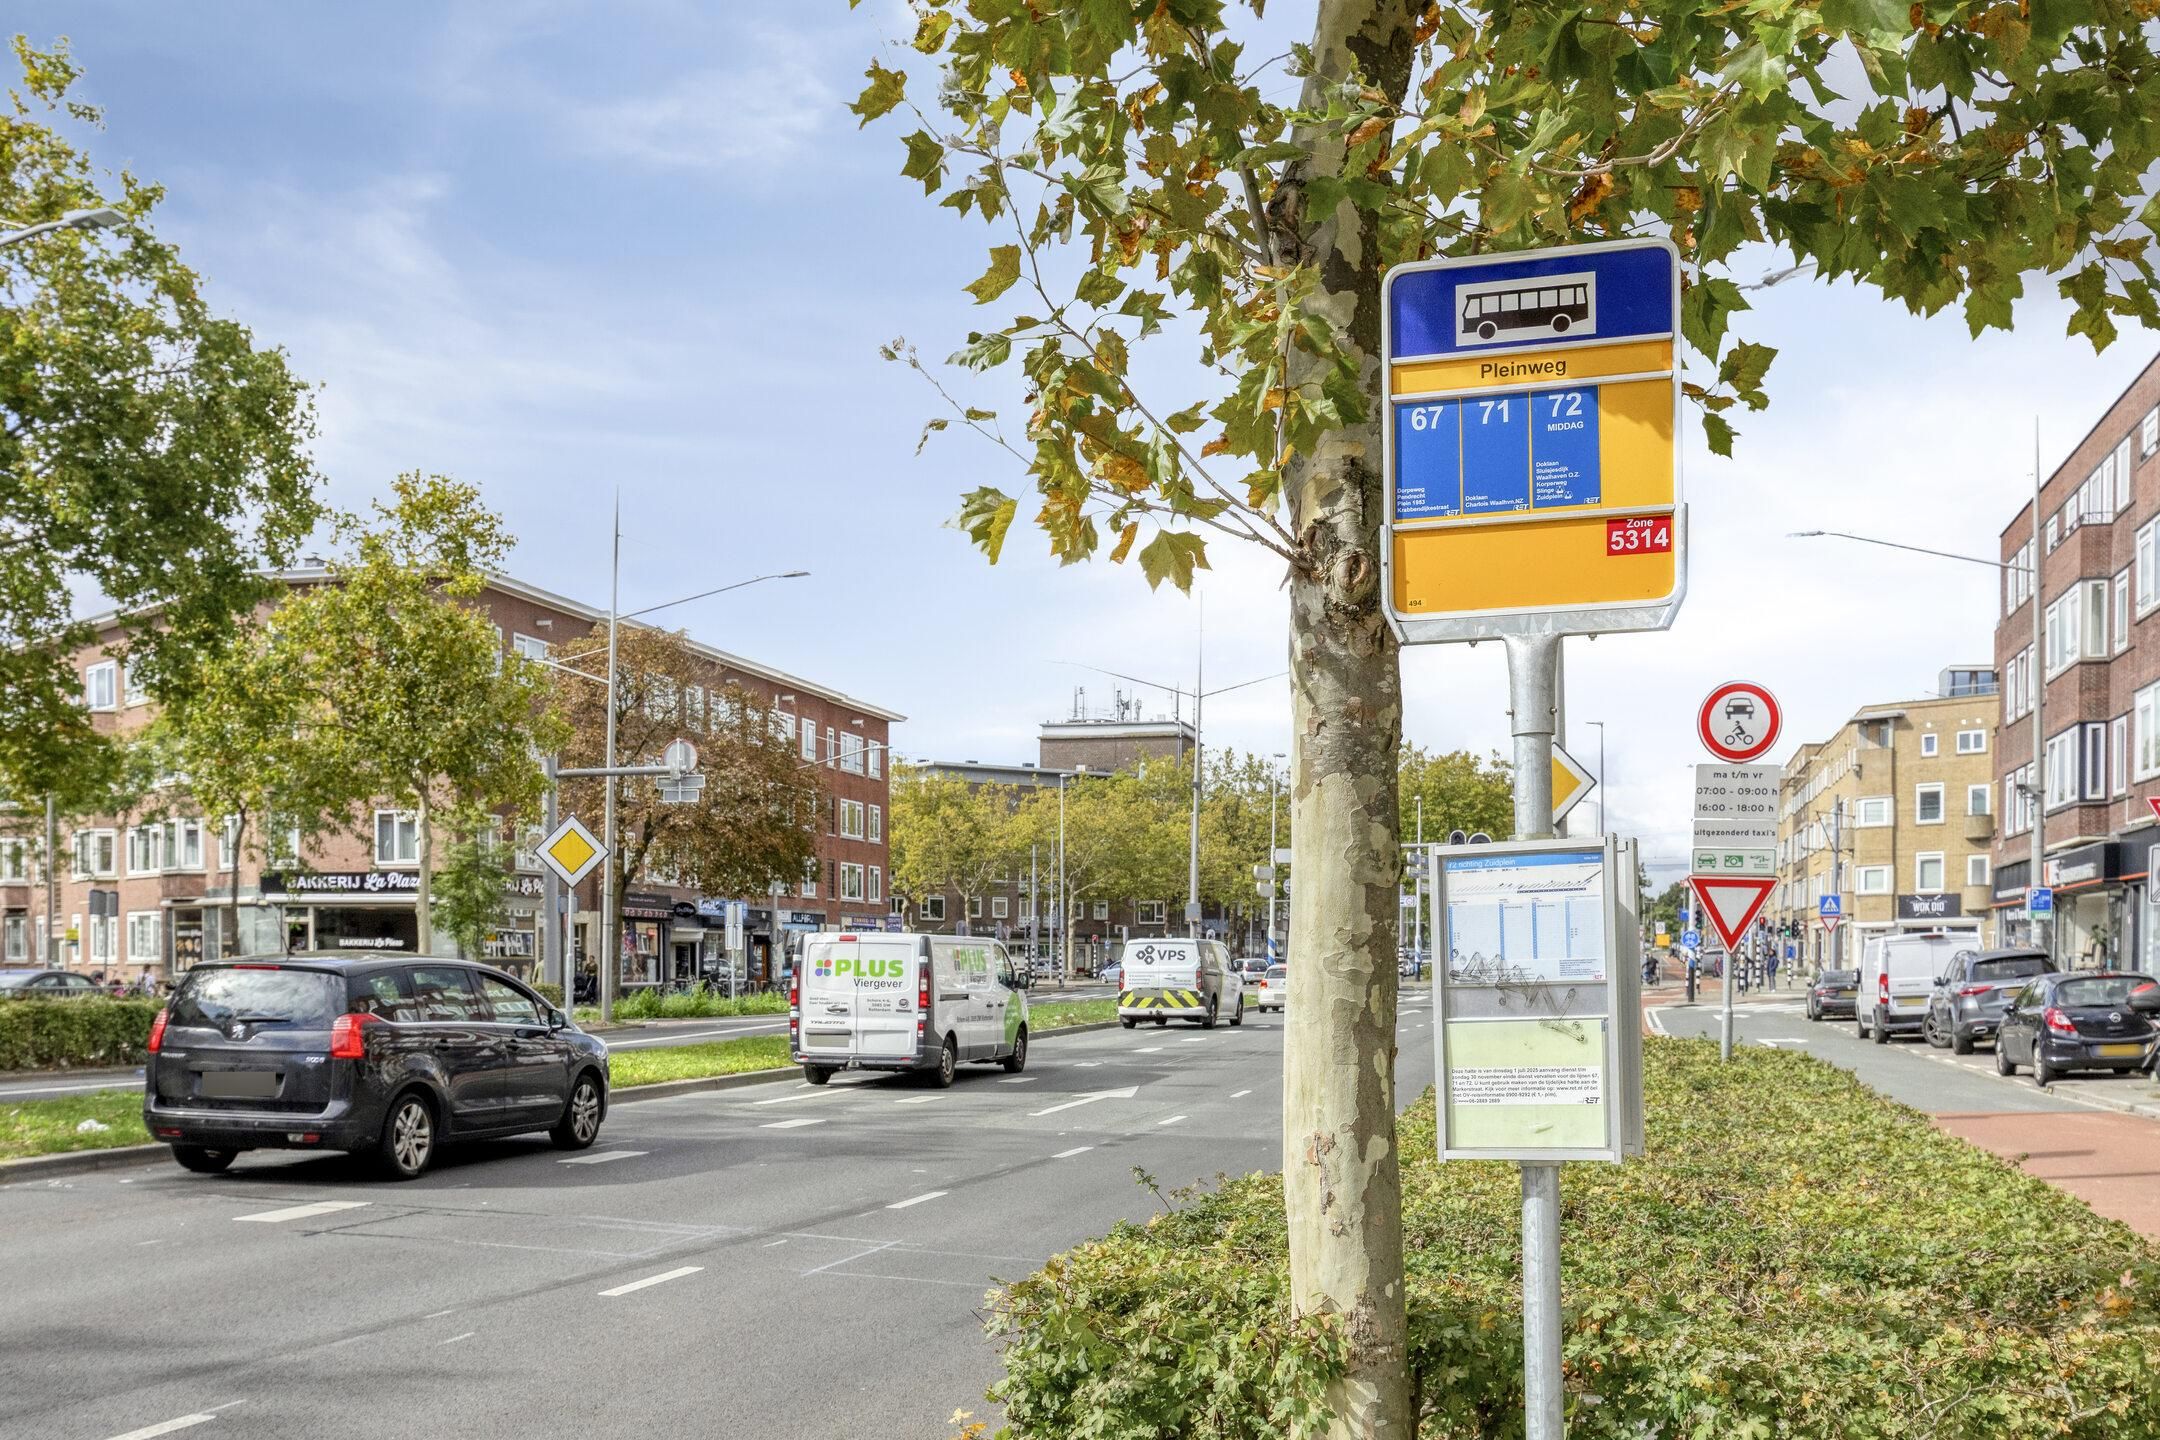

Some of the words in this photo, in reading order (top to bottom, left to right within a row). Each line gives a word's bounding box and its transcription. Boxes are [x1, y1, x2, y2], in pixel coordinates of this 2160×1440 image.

[1480, 358, 1567, 379] Pleinweg
[1549, 391, 1583, 418] 72
[1479, 399, 1510, 425] 71
[1411, 405, 1444, 431] 67
[1547, 420, 1584, 432] MIDDAG
[1537, 493, 1563, 501] Zuidplein
[1584, 496, 1600, 504] RET
[1397, 504, 1449, 513] Krabbendijkestraat
[1444, 508, 1460, 516] RET
[1513, 503, 1529, 511] RET
[1626, 518, 1654, 528] Zone
[1610, 527, 1669, 550] 5314
[1408, 599, 1422, 607] 494
[1713, 771, 1728, 779] ma
[1731, 770, 1749, 779] t/m
[1696, 787, 1726, 795] 07:00
[1737, 787, 1768, 796] 09:00
[1771, 788, 1778, 796] h
[1698, 804, 1726, 812] 16:00
[1737, 804, 1765, 812] 18:00
[1768, 804, 1774, 812] h
[1694, 829, 1750, 838] uitgezonderd
[1752, 829, 1776, 837] taxi's
[1458, 860, 1483, 868] richting
[1484, 858, 1516, 867] Zuidplein
[364, 872, 387, 891] La
[387, 872, 420, 889] Plaz
[2032, 890, 2040, 901] P
[1912, 901, 1930, 914] WOK
[339, 938, 374, 947] BAKKERIJ
[374, 937, 385, 948] La
[1157, 949, 1186, 961] VPS
[835, 958, 904, 977] PLUS
[853, 978, 903, 989] Viergever
[1584, 1096, 1601, 1104] RET
